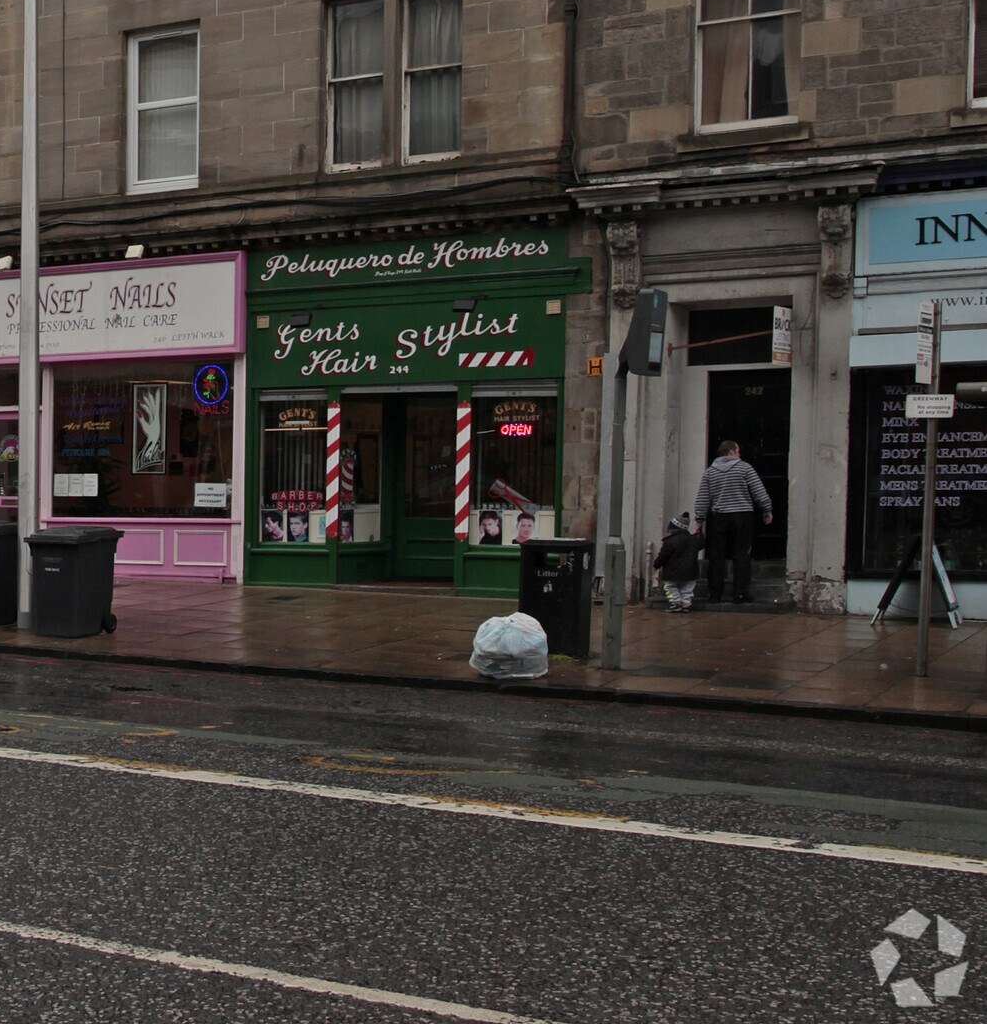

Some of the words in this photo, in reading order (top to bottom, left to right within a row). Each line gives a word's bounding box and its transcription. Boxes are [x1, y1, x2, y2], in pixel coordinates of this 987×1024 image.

[261, 252, 394, 281] Peluquero
[398, 245, 425, 266] de
[427, 237, 550, 269] Hombres
[5, 279, 93, 318] SNSET
[109, 277, 177, 311] NAILS
[104, 315, 137, 330] NAIL
[142, 313, 178, 328] CARE
[171, 331, 198, 343] LEITH
[199, 330, 226, 341] WALK
[274, 321, 360, 360] Gents
[395, 312, 520, 359] Stylist
[301, 349, 378, 376] Hair
[589, 359, 602, 375] H
[389, 365, 409, 374] 244
[744, 385, 764, 396] 242
[193, 400, 230, 416] NAILS
[494, 400, 537, 415] GENT'S
[278, 408, 317, 421] GENT'S
[512, 414, 540, 422] STYLIST
[882, 417, 919, 428] MINX
[500, 423, 532, 436] OPEN
[881, 433, 909, 443] EYE
[881, 448, 921, 459] BODY
[880, 480, 918, 491] MENS
[271, 490, 323, 500] BARBER
[879, 496, 923, 507] SPRAY
[276, 501, 318, 512] SHOP
[537, 569, 559, 577] Litter
